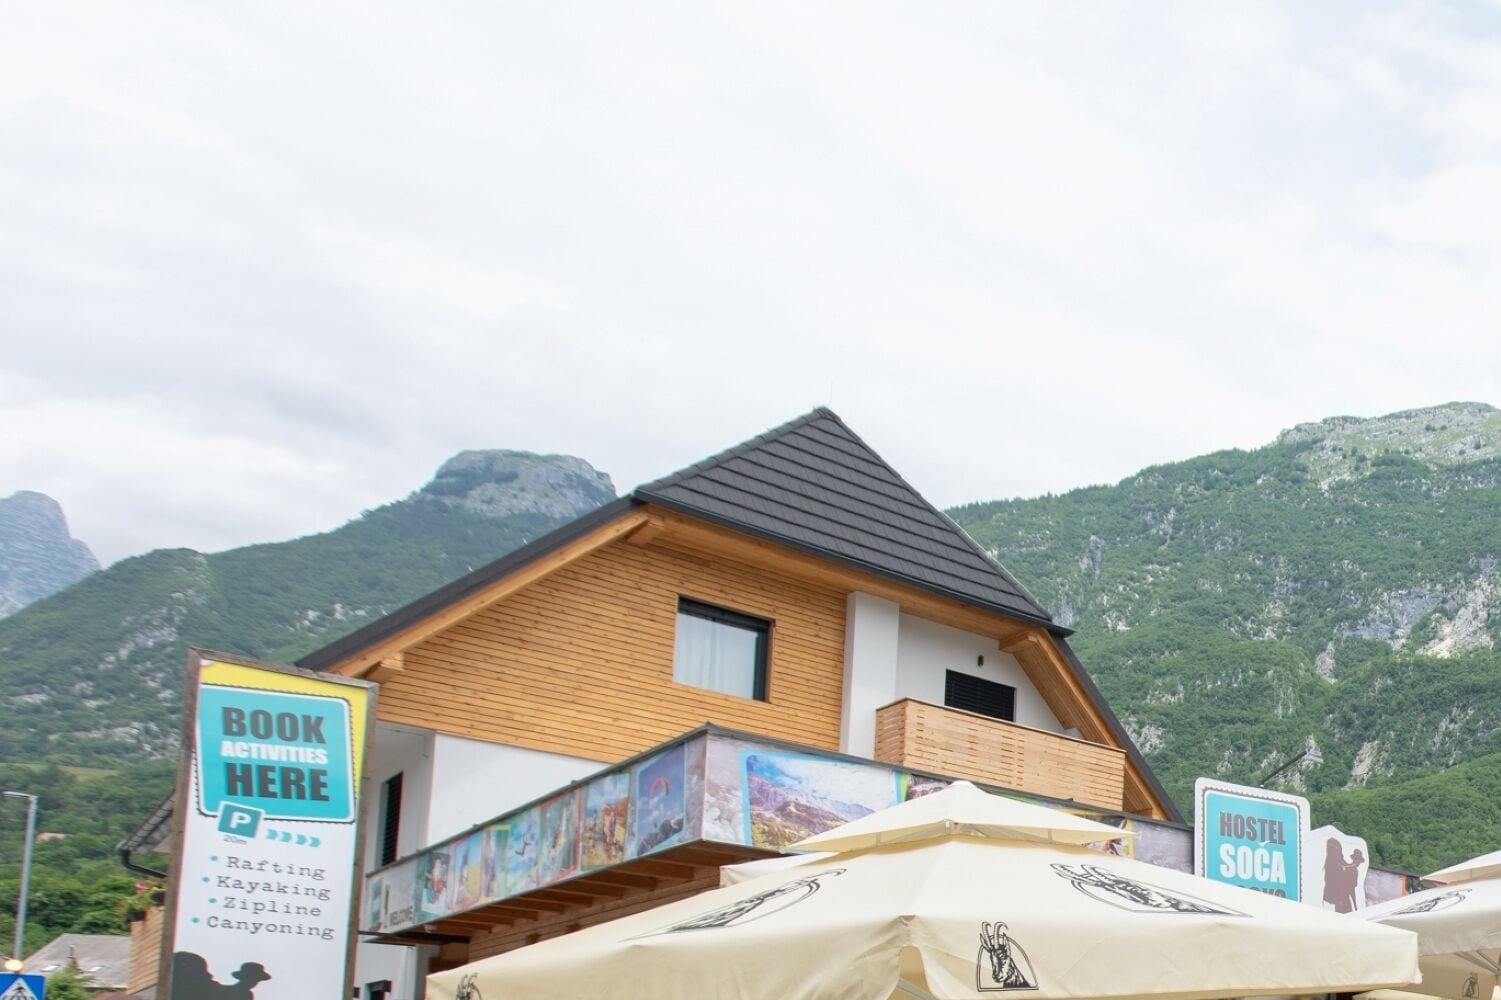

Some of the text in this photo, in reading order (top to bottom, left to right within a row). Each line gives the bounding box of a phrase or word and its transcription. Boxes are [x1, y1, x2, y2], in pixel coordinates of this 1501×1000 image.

[223, 707, 326, 743] BOOK
[221, 741, 328, 764] ACTIVITIES
[225, 763, 329, 801] HERE
[230, 811, 253, 829] P
[1220, 812, 1286, 844] HOSTEL
[227, 856, 327, 881] Rafting
[1219, 840, 1286, 883] SOČA
[216, 875, 332, 901] Kayaking
[223, 896, 322, 917] Zipline
[206, 915, 336, 940] Canyoning
